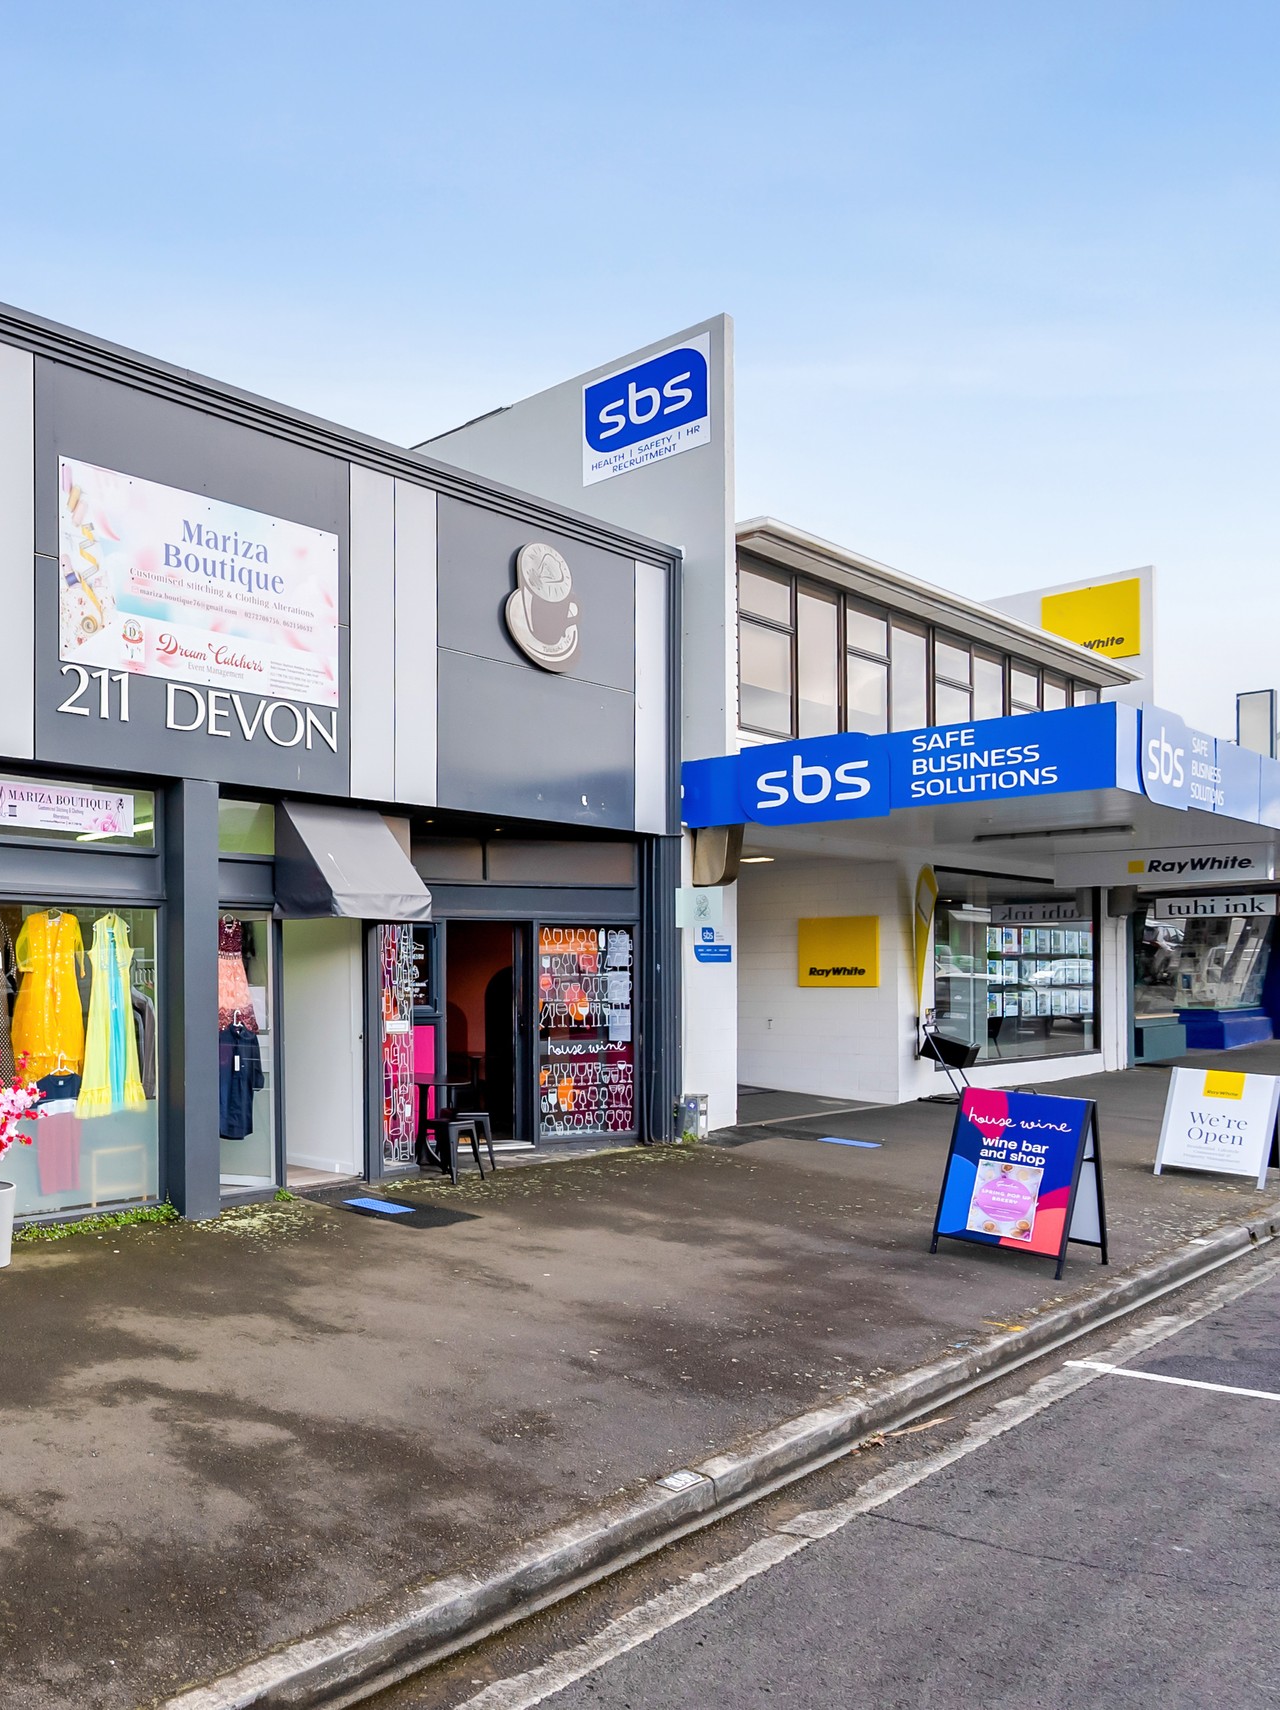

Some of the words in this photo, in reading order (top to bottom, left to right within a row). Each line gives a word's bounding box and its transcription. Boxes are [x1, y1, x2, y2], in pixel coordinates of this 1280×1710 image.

[599, 371, 693, 440] sbs
[591, 453, 625, 471] HEALTH
[637, 435, 673, 454] SAFETY
[686, 425, 701, 436] HR
[612, 443, 677, 473] RECRUITMENT
[181, 519, 269, 564] Mariza
[163, 543, 285, 594] Boutique
[129, 567, 184, 587] Customised
[226, 591, 233, 599] &
[235, 592, 270, 609] Clothing
[272, 602, 315, 618] Alterations
[156, 633, 207, 661] Dream
[188, 662, 205, 673] Event
[206, 663, 245, 680] Management
[57, 664, 129, 722] 211
[166, 683, 338, 753] DEVON
[912, 729, 975, 753] SAFE
[1192, 737, 1209, 758] SAFE
[912, 744, 1040, 776] BUSINESS
[1147, 726, 1185, 788] sbs
[756, 754, 871, 809] sbs
[910, 766, 1058, 798] SOLUTIONS
[1191, 760, 1222, 784] BUSINESS
[8, 789, 53, 804] MARIZA
[56, 794, 112, 811] BOUTIQUE
[1190, 782, 1225, 806] SOLUTIONS
[1168, 899, 1216, 916] tuhi
[1224, 897, 1266, 914] ink
[703, 930, 714, 940] sbs
[548, 1036, 586, 1056] house
[588, 1040, 626, 1053] wine
[968, 1106, 1017, 1128] house
[1020, 1119, 1072, 1133] wine
[1190, 1111, 1248, 1130] We're
[982, 1136, 1018, 1150] wine
[1021, 1140, 1049, 1154] bar
[1187, 1126, 1244, 1146] Open
[979, 1148, 1007, 1160] and
[1010, 1151, 1046, 1167] shop
